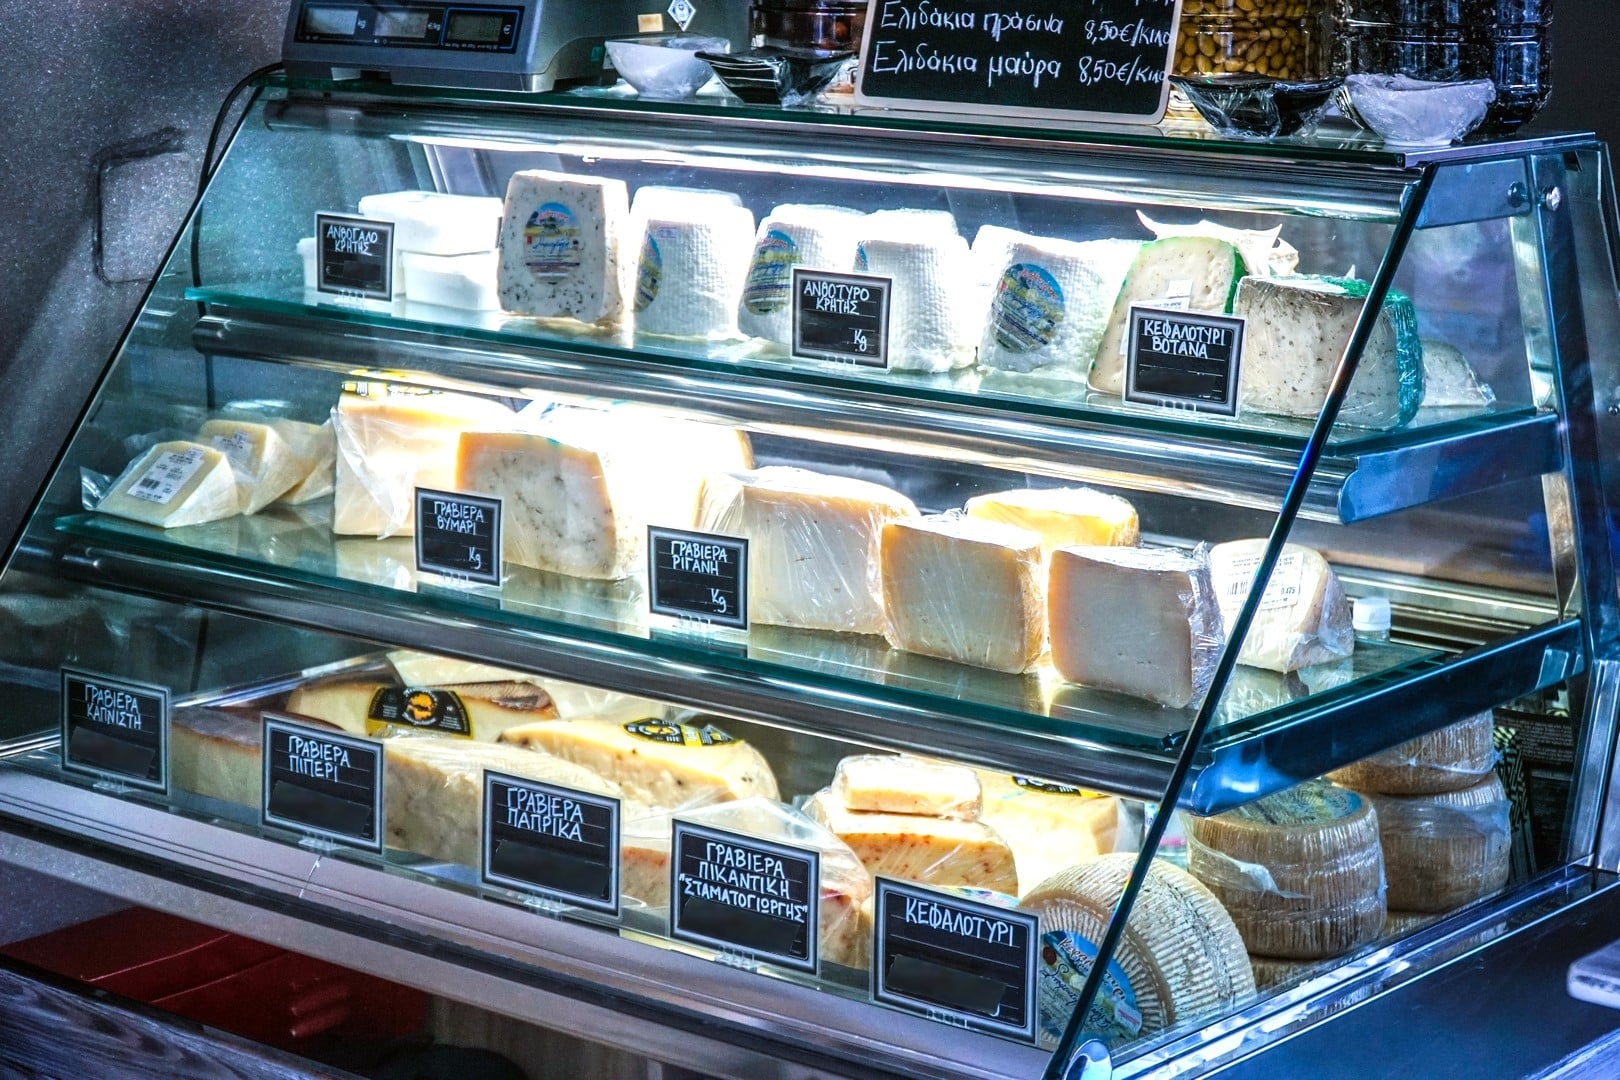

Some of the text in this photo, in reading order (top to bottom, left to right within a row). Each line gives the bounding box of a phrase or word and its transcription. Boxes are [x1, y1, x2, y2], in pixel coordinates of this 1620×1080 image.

[881, 0, 975, 30] Ελιδάκια
[873, 41, 977, 74] Ελιδάκια
[988, 51, 1062, 88] μαύρα
[326, 224, 379, 243] ΑΝΘΟΓΑΛΟ
[334, 239, 373, 257] ΚΡΗΤΗΣ
[803, 280, 870, 302] ΑΝΘΟΤΥΡΟ
[815, 296, 860, 316] ΚΡΗΤΗΣ
[1143, 318, 1226, 347] ΚΕΦΑΛΟΤΥΡΙ
[1151, 335, 1209, 360] ΒΟΤΑΝΑ
[433, 501, 485, 523] ΓΡΑΒΙΕΡΑ
[436, 515, 476, 536] ΘΥΜΑΡΙ
[670, 540, 728, 564] ΓΡΑΒΙΕΡΑ
[671, 554, 720, 576] ΡΙΓΑΝΗ
[85, 684, 140, 714] ΓΡΑΒΙΕΡΑ
[86, 702, 142, 731] ΚΑΠΝΙΣΤΗ
[288, 735, 351, 769] ΓΡΑΒΙΕΡΑ
[288, 754, 339, 783] ΠΙΠΕΡΙ
[507, 787, 584, 824] ΓΡΑΒΙΕΡΑ
[507, 807, 583, 843] ΠΑΠΡΙΚΑ
[706, 842, 786, 880] ΓΡΑΒΙΕΡΑ
[698, 861, 790, 900] ΠΙΚΑΝΤΙΚΗ
[905, 897, 1015, 947] ΚΕΦΑΛΟΤΥΡΙ
